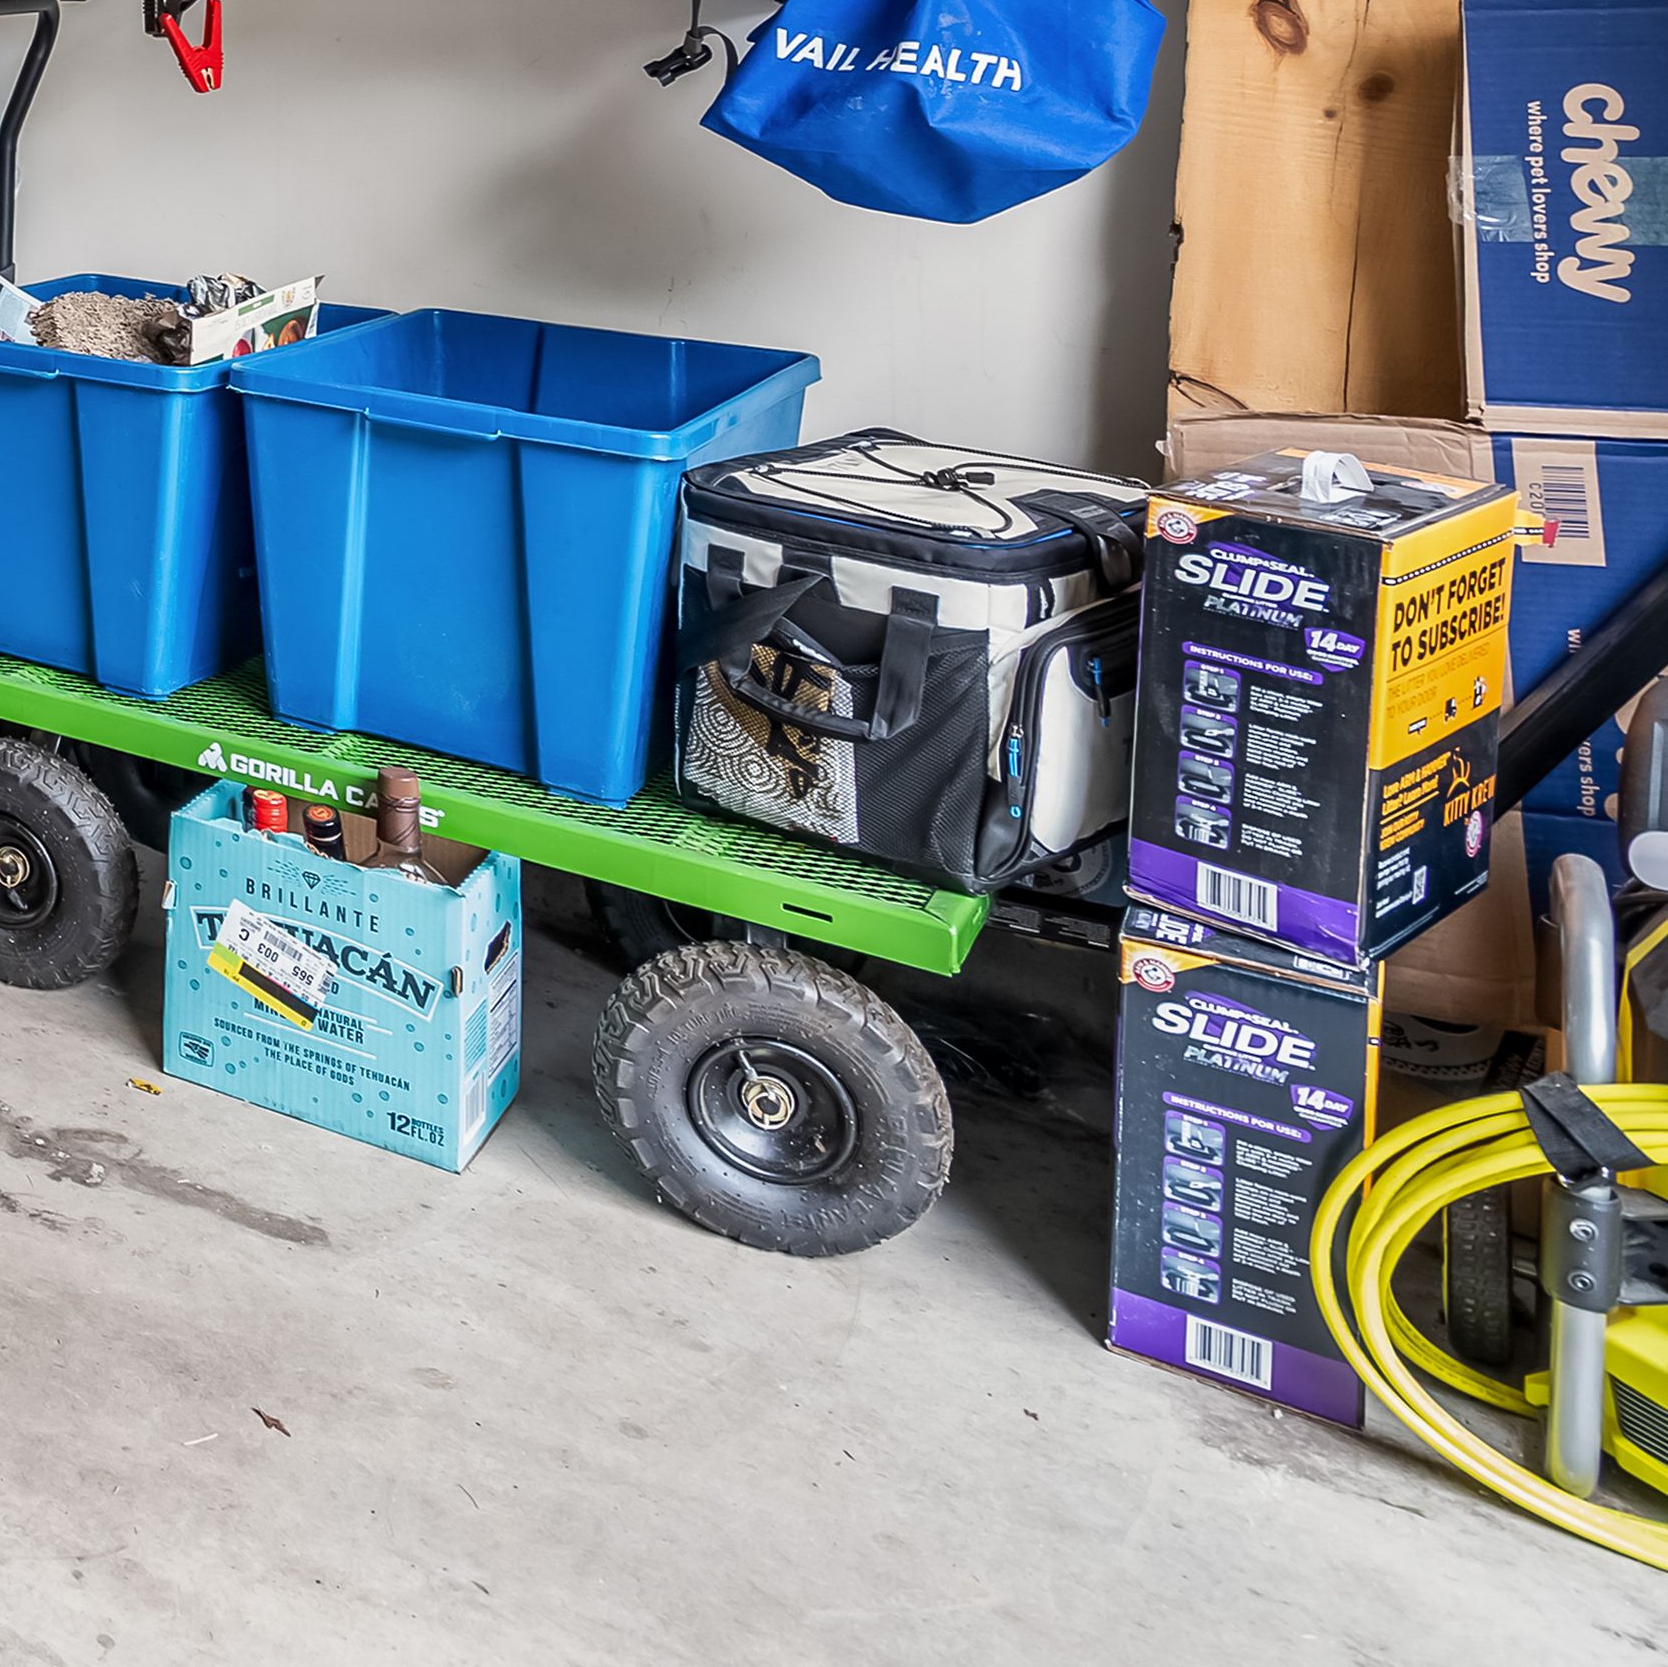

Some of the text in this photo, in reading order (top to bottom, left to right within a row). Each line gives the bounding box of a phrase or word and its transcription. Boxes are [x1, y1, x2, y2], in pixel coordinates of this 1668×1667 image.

[776, 28, 1023, 92] VAIL HEALTH
[1525, 101, 1555, 283] where pet lovers shop
[1557, 83, 1640, 303] chewy
[1174, 553, 1330, 612] SLIDE
[1393, 557, 1506, 633] DON'T FORGET
[1203, 595, 1304, 628] PLATINUM
[1392, 592, 1506, 672] TO SUBSCRIBE!
[1311, 630, 1361, 653] 14 DAY
[1189, 645, 1313, 681] INSTRUCTIONS FOR USE:
[1200, 663, 1219, 674] STEP
[1196, 708, 1215, 720] STEP
[1194, 754, 1213, 765] STEP
[230, 754, 440, 829] GORILLA CAS
[1191, 799, 1210, 810] STEP
[1443, 773, 1497, 827] KITTY KREW
[1577, 774, 1601, 817] shop
[246, 878, 380, 933] BRILLANTE
[238, 928, 314, 986] 565 003 C
[317, 1018, 364, 1044] WATER
[1152, 1002, 1316, 1070] SLIDE
[214, 1018, 411, 1092] SOURCED FROM THE SPRINGS OF TEHUACÁN
[264, 1048, 355, 1086] THE PLACE OF GODS
[1183, 1045, 1290, 1084] PLATINUM
[1170, 1095, 1302, 1139] INSTRUCTIONS FOR USE:
[1297, 1087, 1349, 1113] 14 DAY
[386, 1111, 411, 1136] 12
[411, 1117, 444, 1134] BOTTLES
[411, 1127, 445, 1147] FL.OZ
